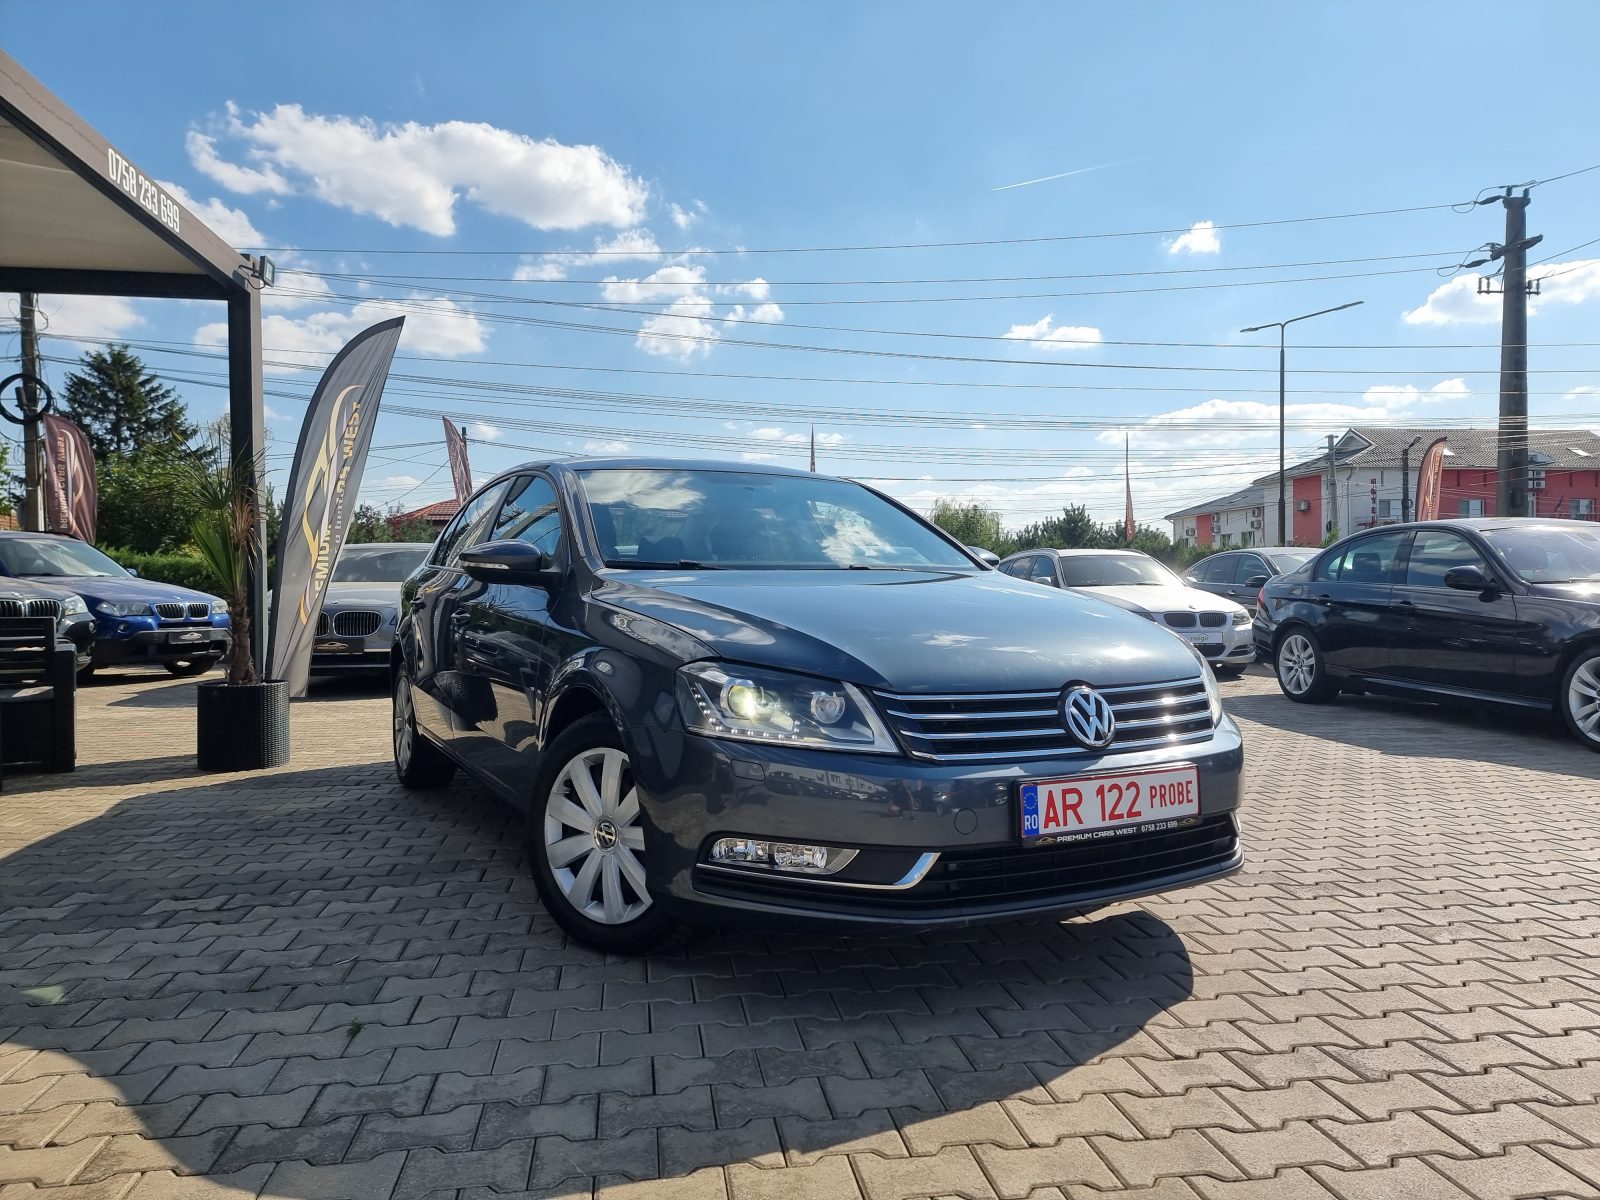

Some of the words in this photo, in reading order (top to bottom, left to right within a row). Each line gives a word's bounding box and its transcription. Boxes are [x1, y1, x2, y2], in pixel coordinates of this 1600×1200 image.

[108, 147, 137, 198] 0758
[138, 174, 159, 216] 233
[160, 193, 180, 234] 699
[1065, 686, 1115, 748] VW
[1024, 814, 1038, 830] RO
[1043, 788, 1084, 829] AR
[1096, 781, 1142, 822] 122
[1149, 780, 1194, 809] PROBE
[1057, 832, 1092, 843] PREMIUM
[1093, 829, 1115, 839] CARS
[1115, 826, 1138, 836] WEST
[1141, 823, 1155, 833] 0758
[1156, 821, 1167, 831] 233
[1167, 820, 1178, 829] 699
